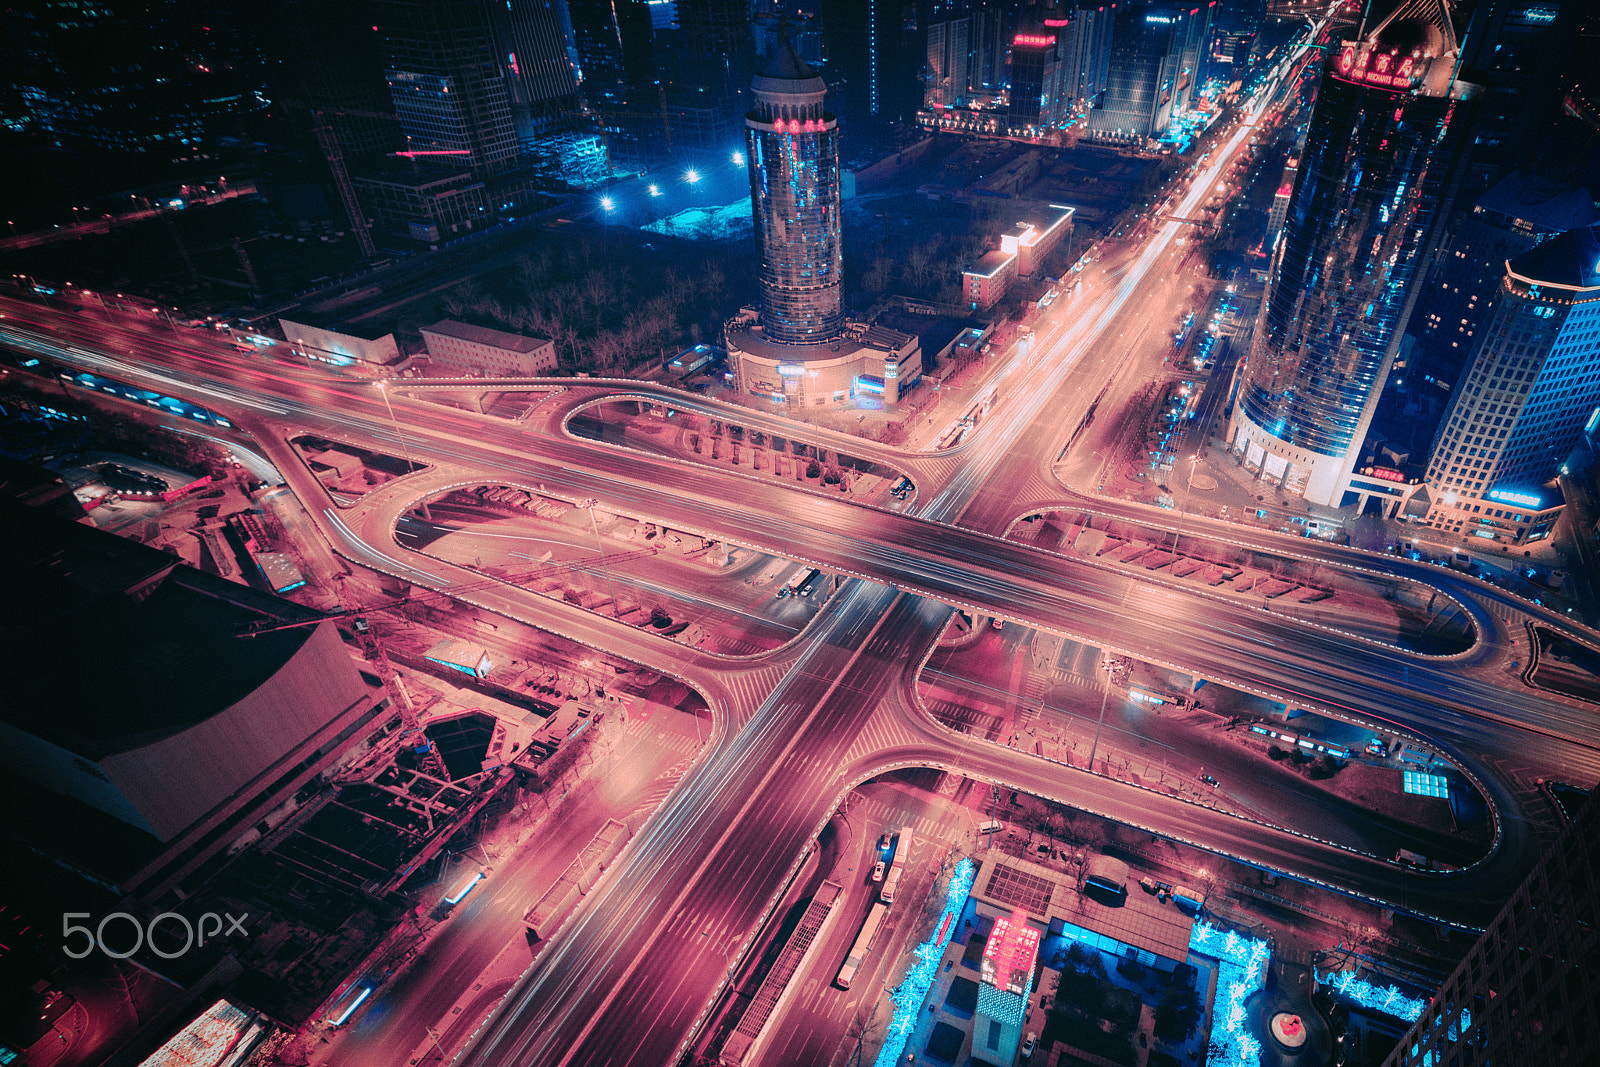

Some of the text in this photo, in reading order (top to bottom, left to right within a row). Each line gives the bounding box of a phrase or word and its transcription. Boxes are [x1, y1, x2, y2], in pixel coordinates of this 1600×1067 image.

[1356, 51, 1413, 77] 招商局
[1366, 72, 1392, 84] MERCHANTS
[1393, 77, 1412, 87] GROUP
